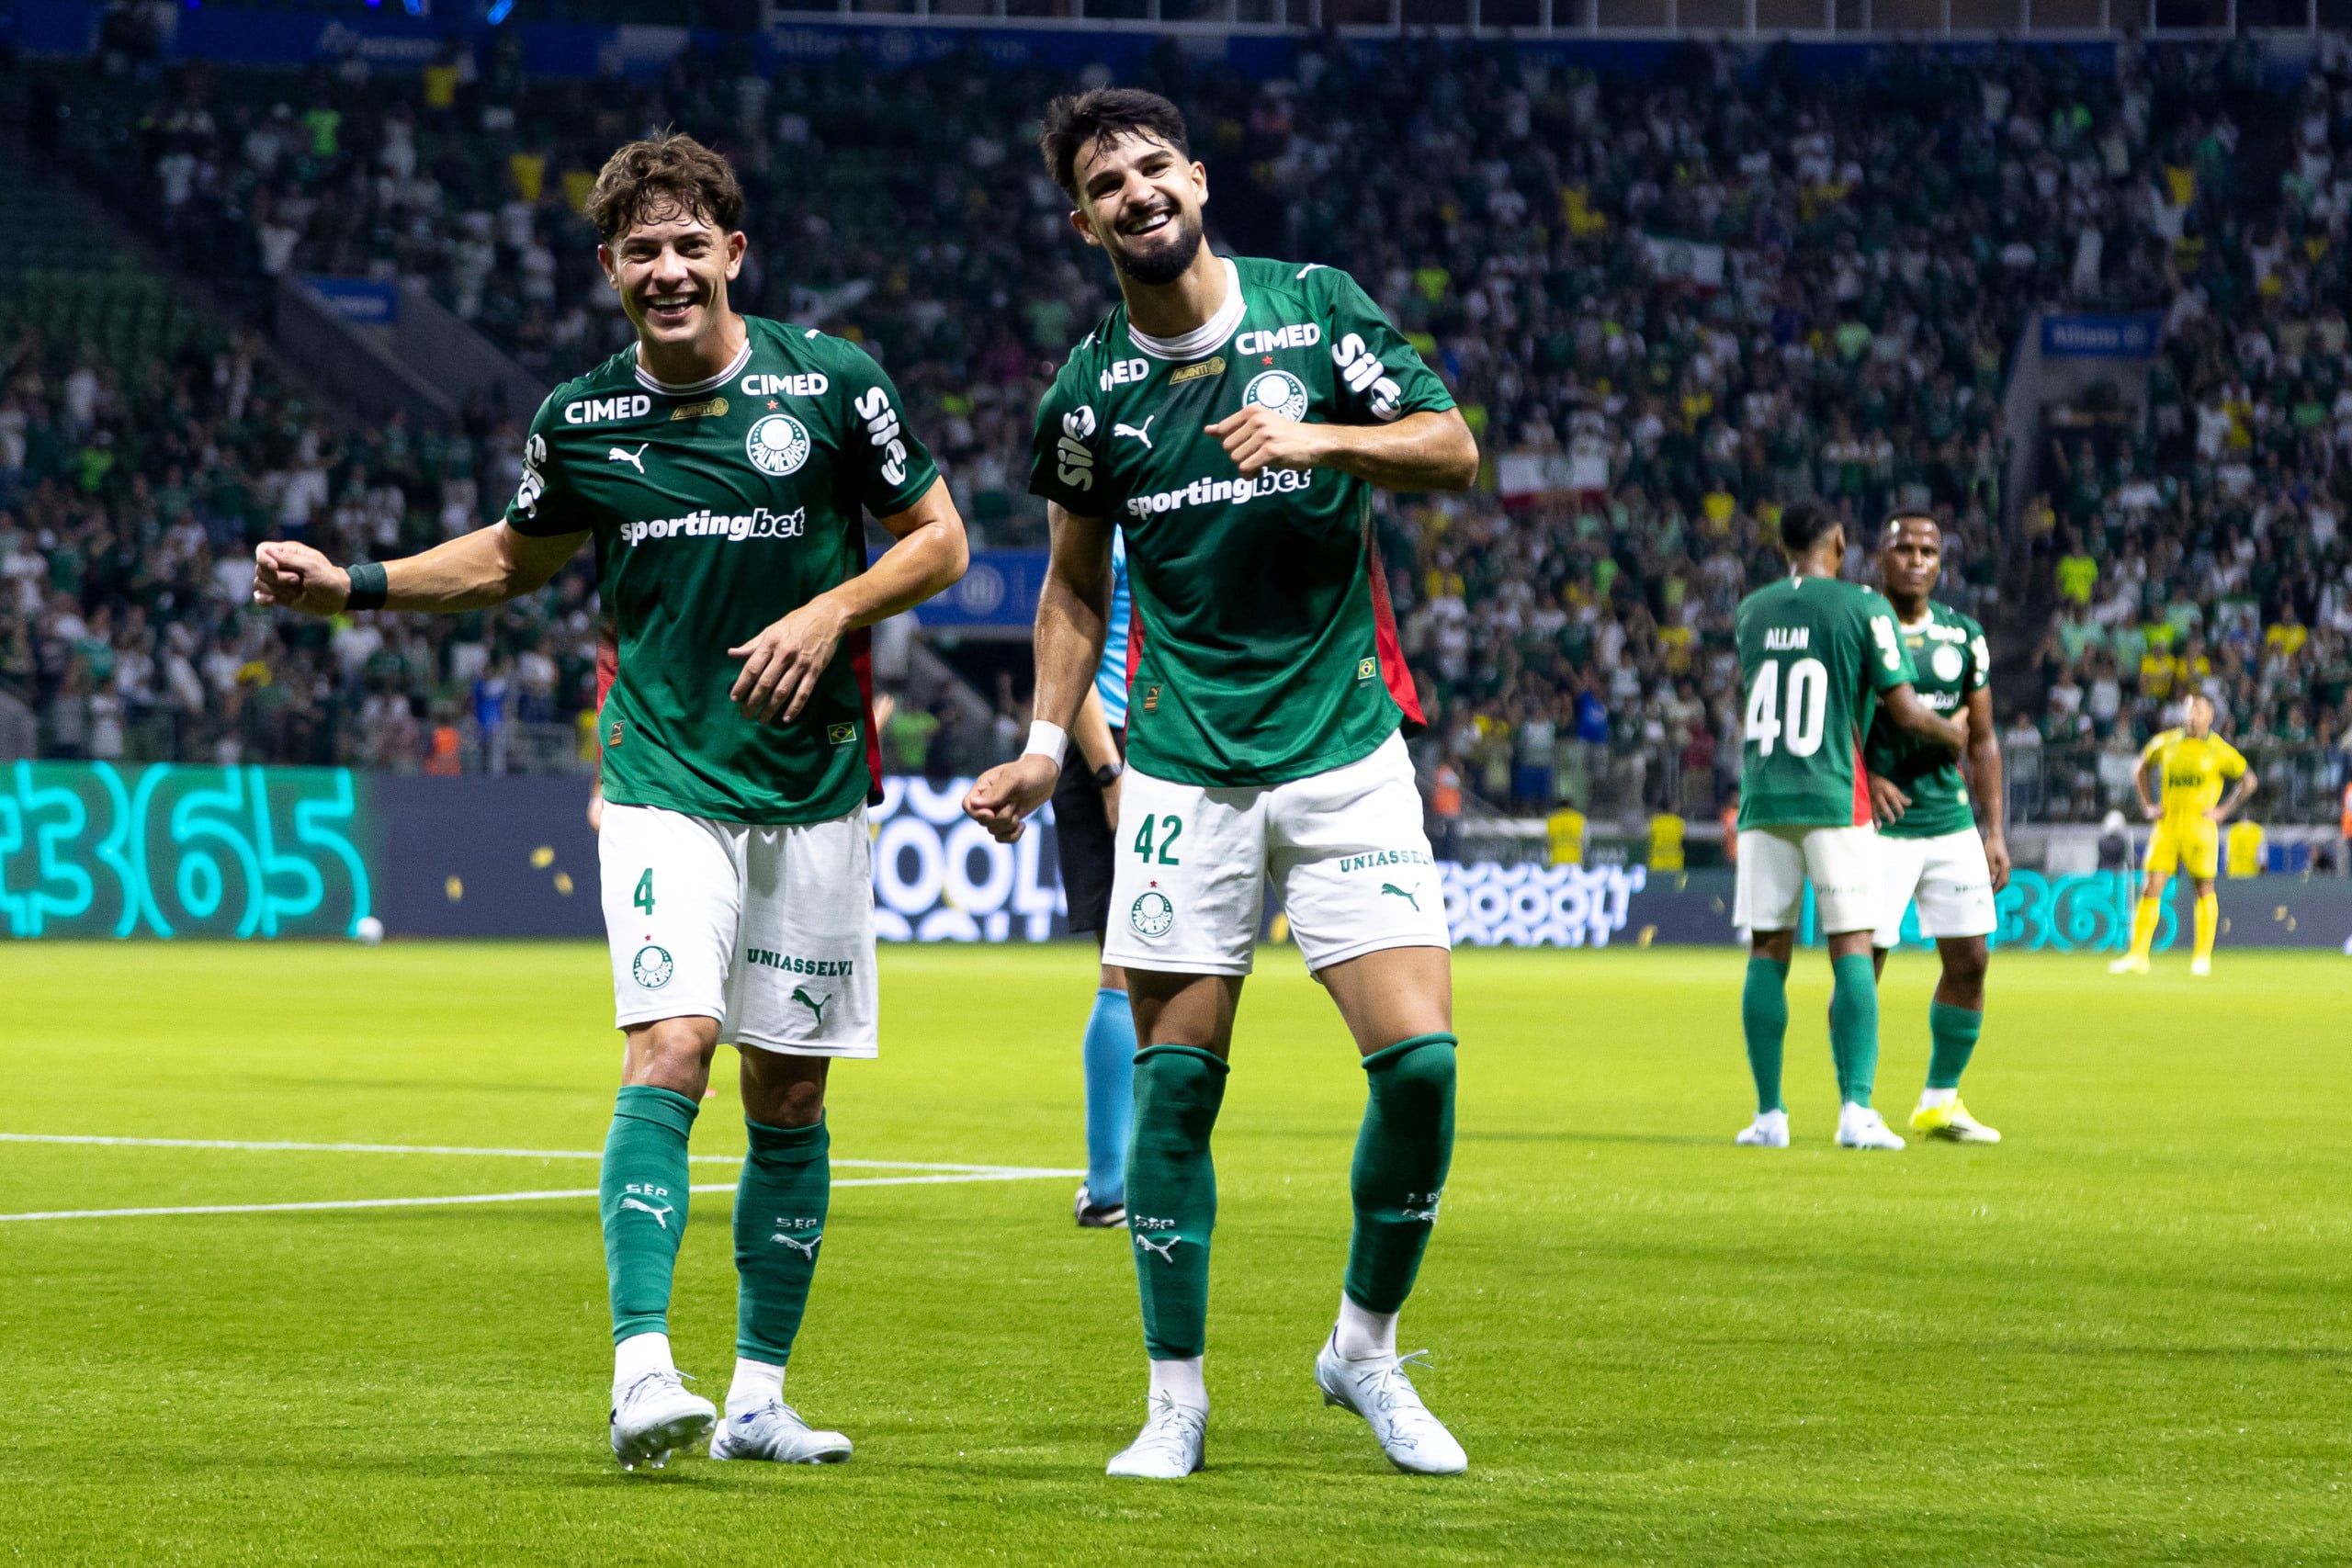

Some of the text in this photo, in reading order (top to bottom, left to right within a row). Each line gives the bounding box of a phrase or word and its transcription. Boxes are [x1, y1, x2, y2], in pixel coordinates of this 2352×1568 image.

[1236, 322, 1320, 355] CIMED
[741, 373, 829, 396] CIMED
[565, 395, 651, 424] CIMED
[751, 438, 806, 472] PALMEIRAS
[1127, 466, 1311, 521] sportingbet
[620, 506, 805, 547] sportingbet
[1765, 626, 1810, 650] ALLAN
[1747, 658, 1828, 757] 40
[0, 759, 370, 939] 365
[1134, 814, 1182, 866] 42
[1340, 850, 1432, 873] UNIASSEL
[633, 868, 655, 916] 4
[1132, 909, 1172, 934] PALMEIRAS
[633, 961, 673, 987] PALMEIRAS
[747, 948, 853, 977] UNIASSELVI
[626, 1182, 668, 1198] SEP
[776, 1217, 817, 1230] SEP
